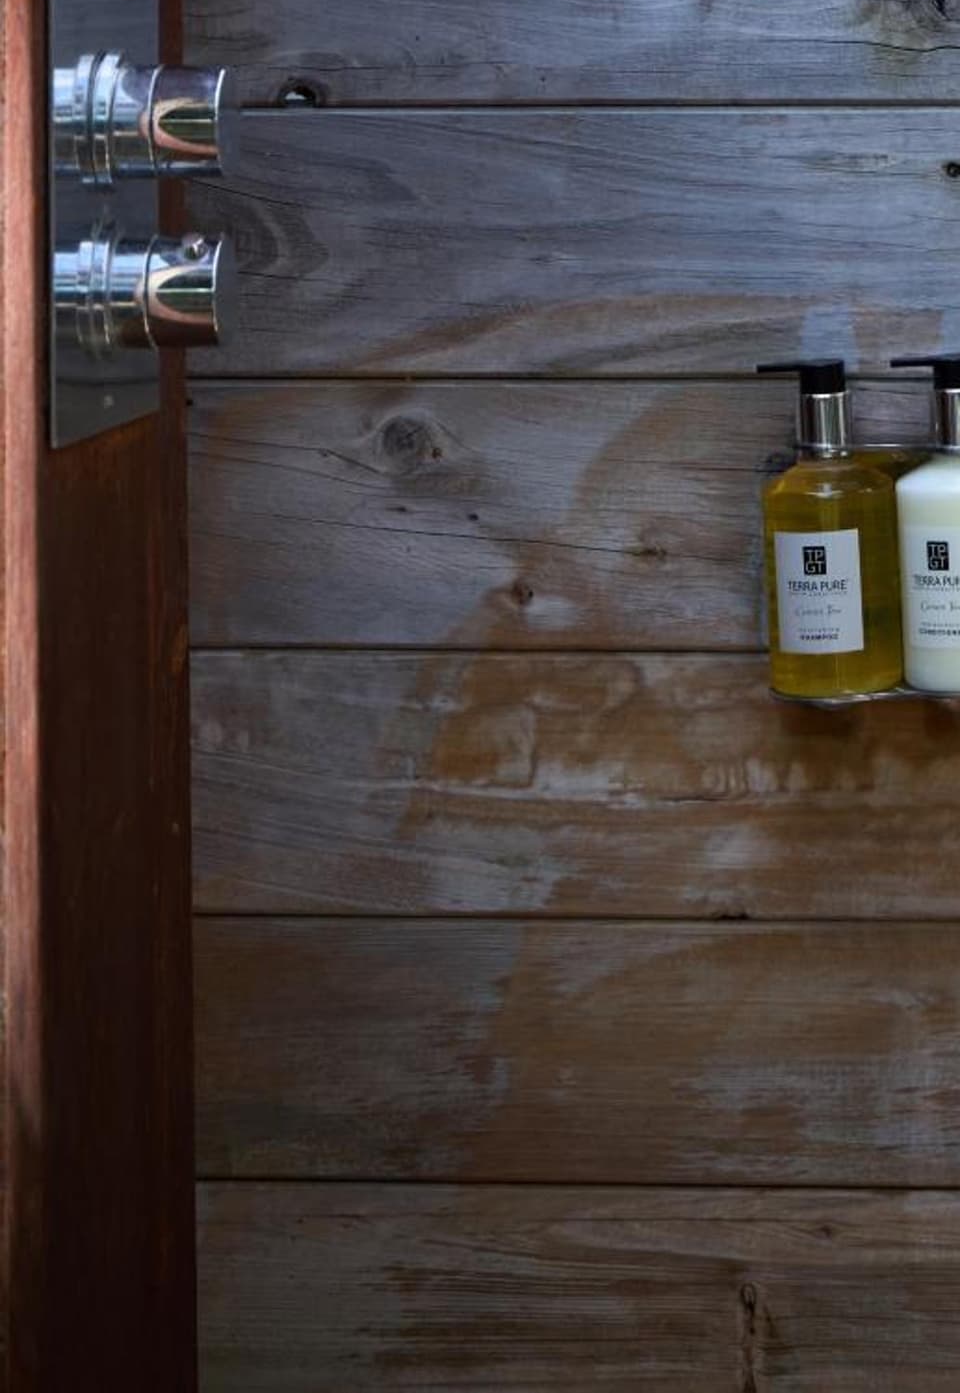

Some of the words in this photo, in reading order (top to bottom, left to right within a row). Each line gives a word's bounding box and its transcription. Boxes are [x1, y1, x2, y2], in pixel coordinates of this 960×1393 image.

[804, 549, 824, 562] TP
[928, 544, 946, 557] TP
[805, 561, 825, 573] GT
[929, 556, 947, 569] GT
[788, 580, 818, 591] TERRA
[914, 575, 942, 586] TERRA
